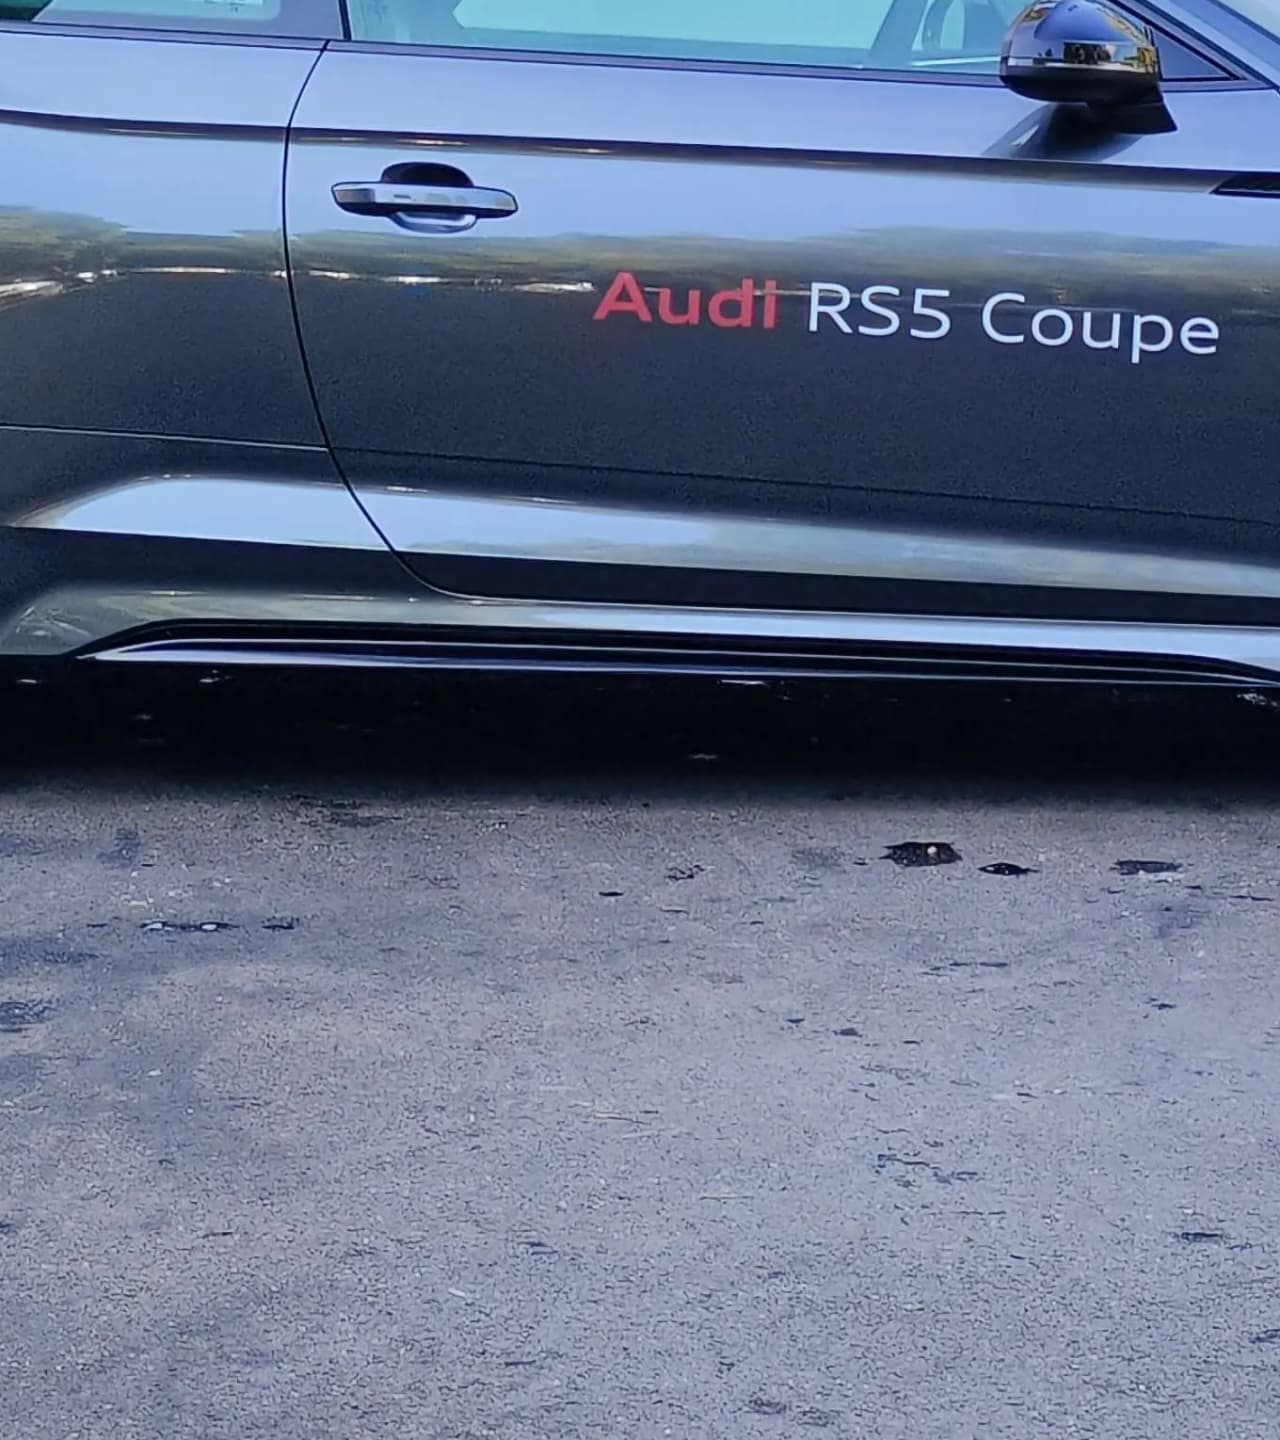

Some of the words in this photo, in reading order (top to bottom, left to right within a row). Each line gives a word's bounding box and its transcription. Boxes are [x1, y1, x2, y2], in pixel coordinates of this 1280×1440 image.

[593, 271, 778, 329] Audi
[807, 281, 952, 339] RS5
[981, 292, 1220, 364] Coupe
